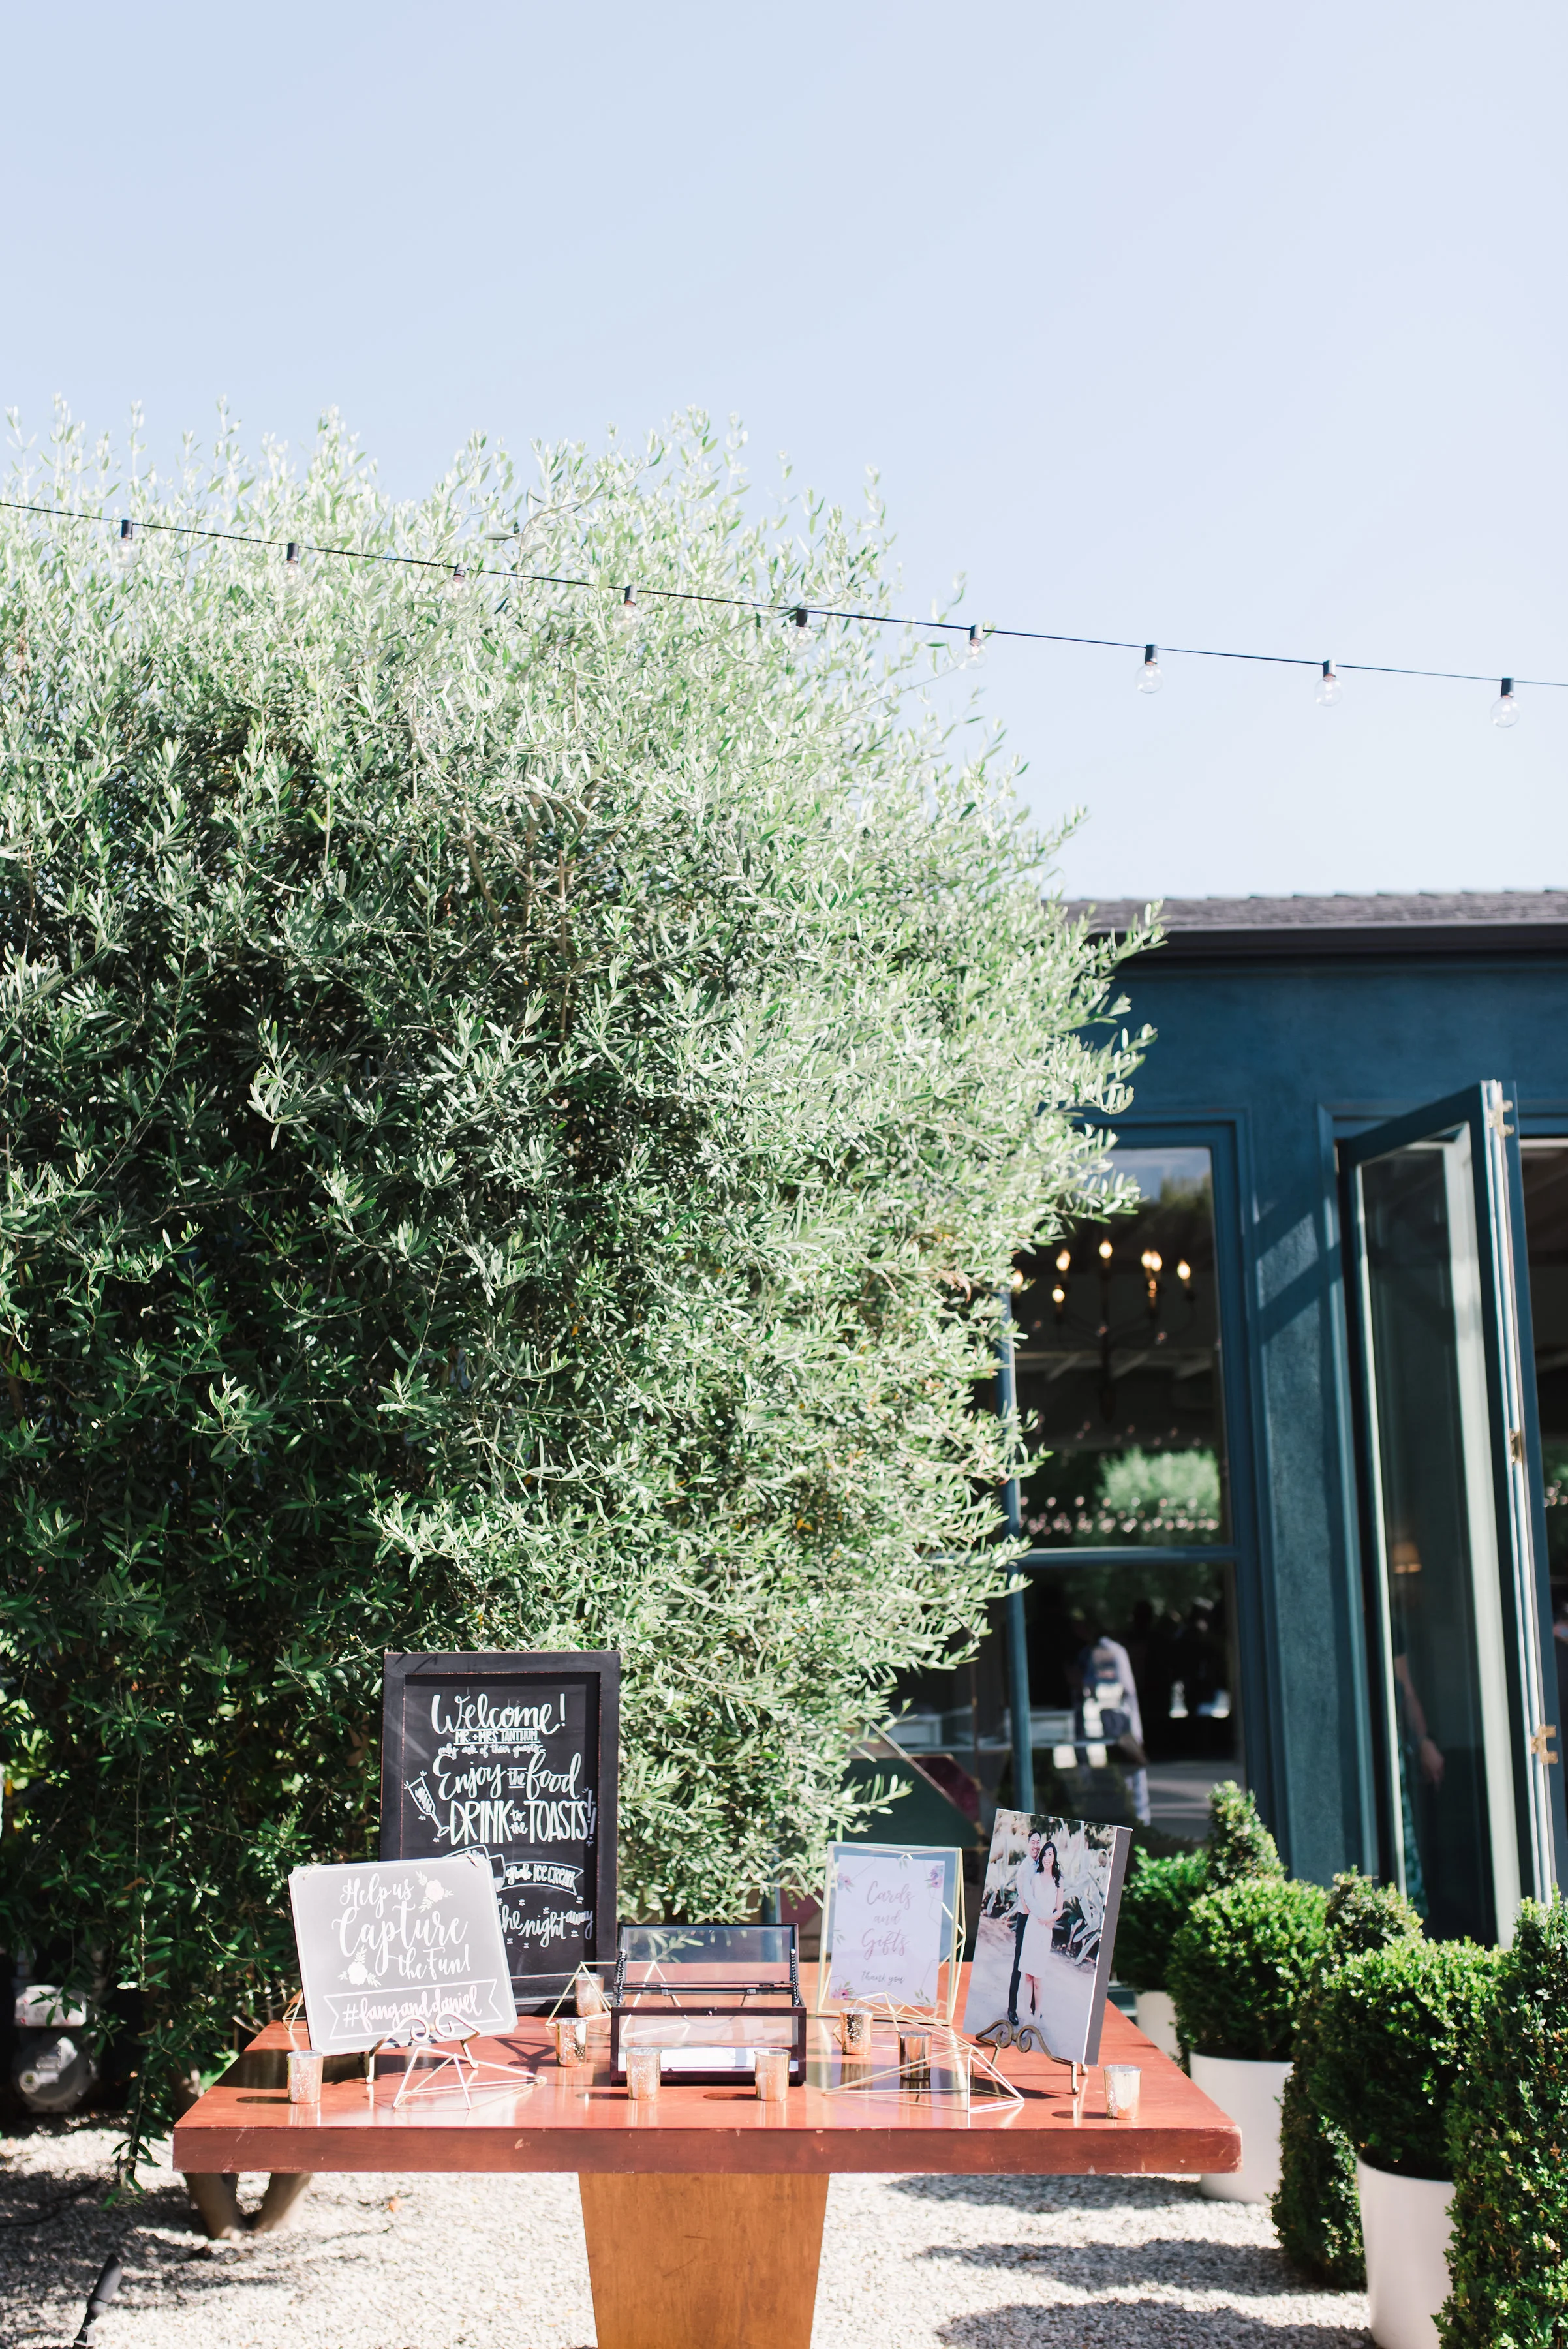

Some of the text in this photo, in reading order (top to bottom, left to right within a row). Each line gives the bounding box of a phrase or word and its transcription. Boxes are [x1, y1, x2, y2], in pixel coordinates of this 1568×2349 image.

[431, 1693, 566, 1735] Welcome!
[480, 1744, 489, 1758] of
[433, 1751, 581, 1801] Enjoy the food
[450, 1800, 514, 1846] DRINK
[509, 1822, 529, 1834] the
[510, 1809, 527, 1821] to
[339, 1873, 415, 1919] Help us
[867, 1880, 915, 1911] Cards
[499, 1904, 594, 1948] he night away
[874, 1910, 902, 1925] and
[331, 1901, 469, 1977] Capture
[861, 1927, 910, 1961] Gifts
[397, 1946, 427, 1981] the
